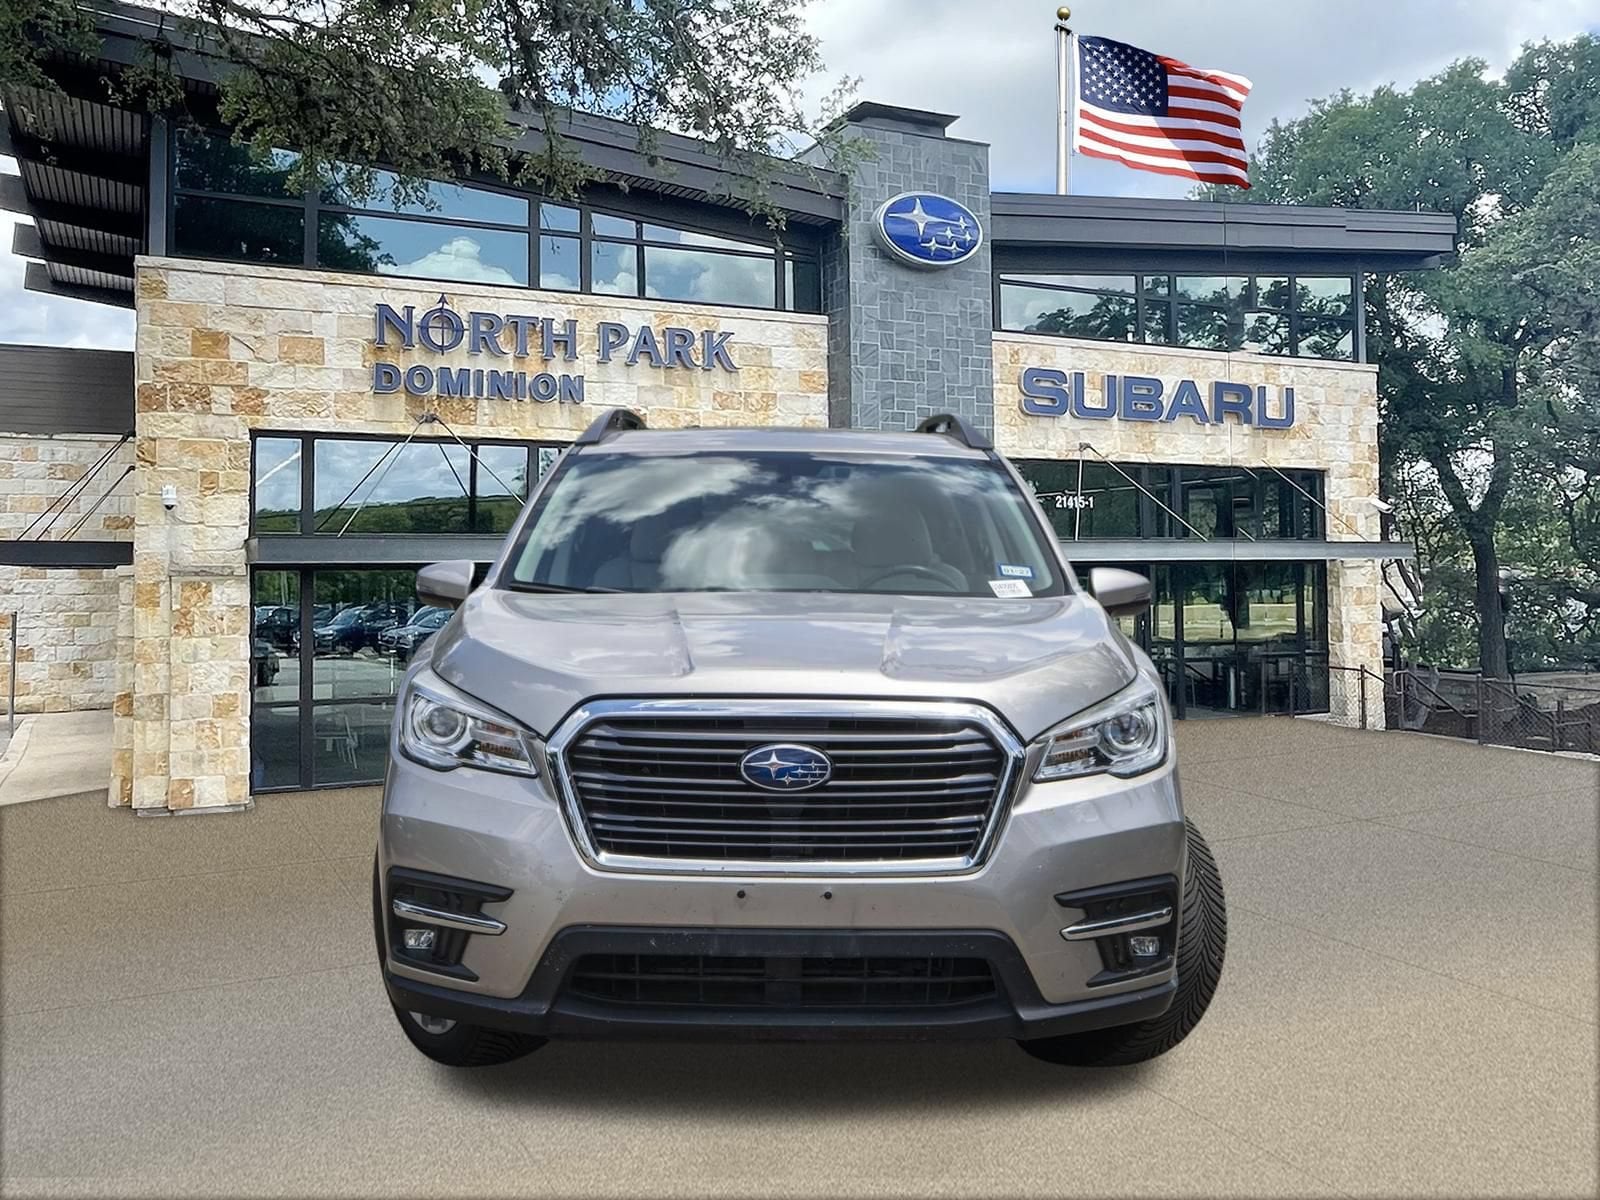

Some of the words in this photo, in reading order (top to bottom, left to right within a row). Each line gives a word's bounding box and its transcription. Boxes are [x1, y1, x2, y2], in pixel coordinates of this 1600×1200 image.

[374, 294, 578, 361] NORTH
[597, 321, 739, 372] PARK
[373, 363, 585, 404] DOMINION
[1019, 366, 1295, 430] SUBARU
